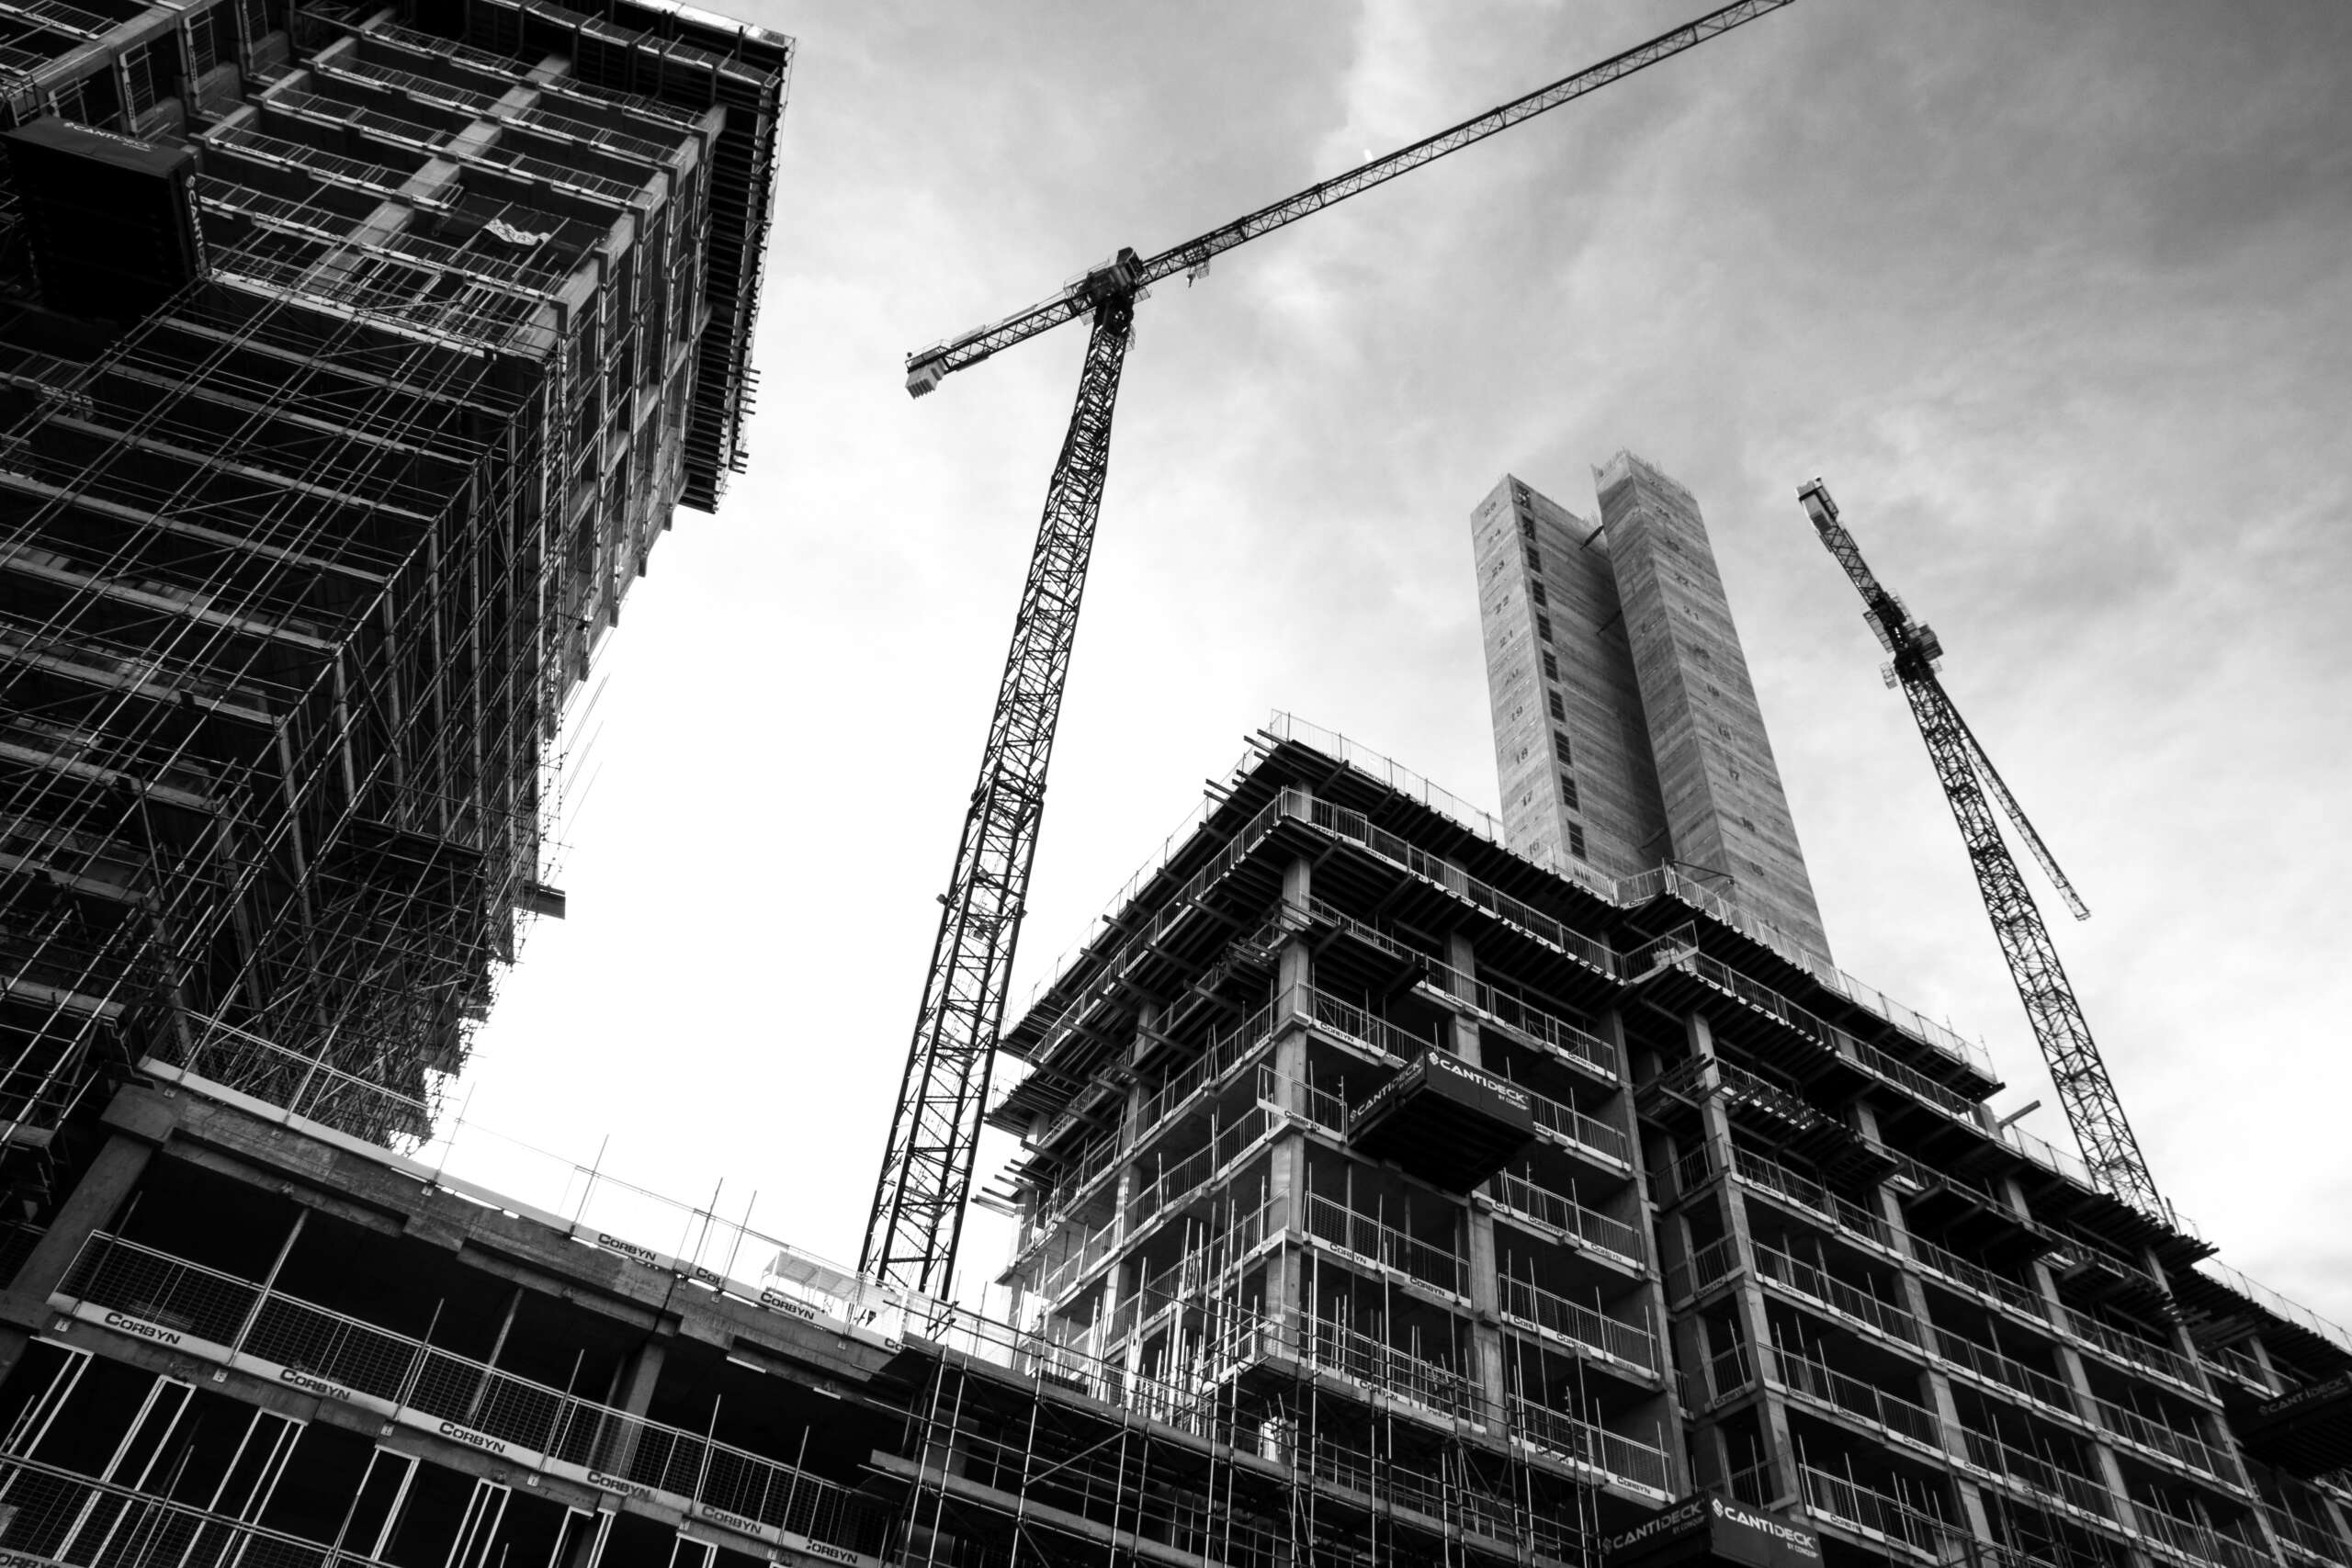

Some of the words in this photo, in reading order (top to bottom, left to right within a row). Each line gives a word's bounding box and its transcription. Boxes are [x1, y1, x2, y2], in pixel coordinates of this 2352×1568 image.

[1511, 706, 1522, 721] 19
[1516, 748, 1528, 764] 18
[1521, 790, 1532, 807] 17
[1356, 1060, 1420, 1116] CANTIDECK
[1441, 1059, 1526, 1104] CANTIDECK
[598, 1234, 656, 1261] CORBYN
[761, 1292, 814, 1320] CORBYN
[105, 1312, 181, 1345] CORBYN
[280, 1369, 350, 1400] CORBYN
[439, 1422, 505, 1453] CORBYN
[588, 1472, 650, 1499] CORBYN
[701, 1506, 763, 1535] CORBYN
[1613, 1502, 1702, 1549] CANTIDECK
[1723, 1506, 1814, 1550] CANTIDECK
